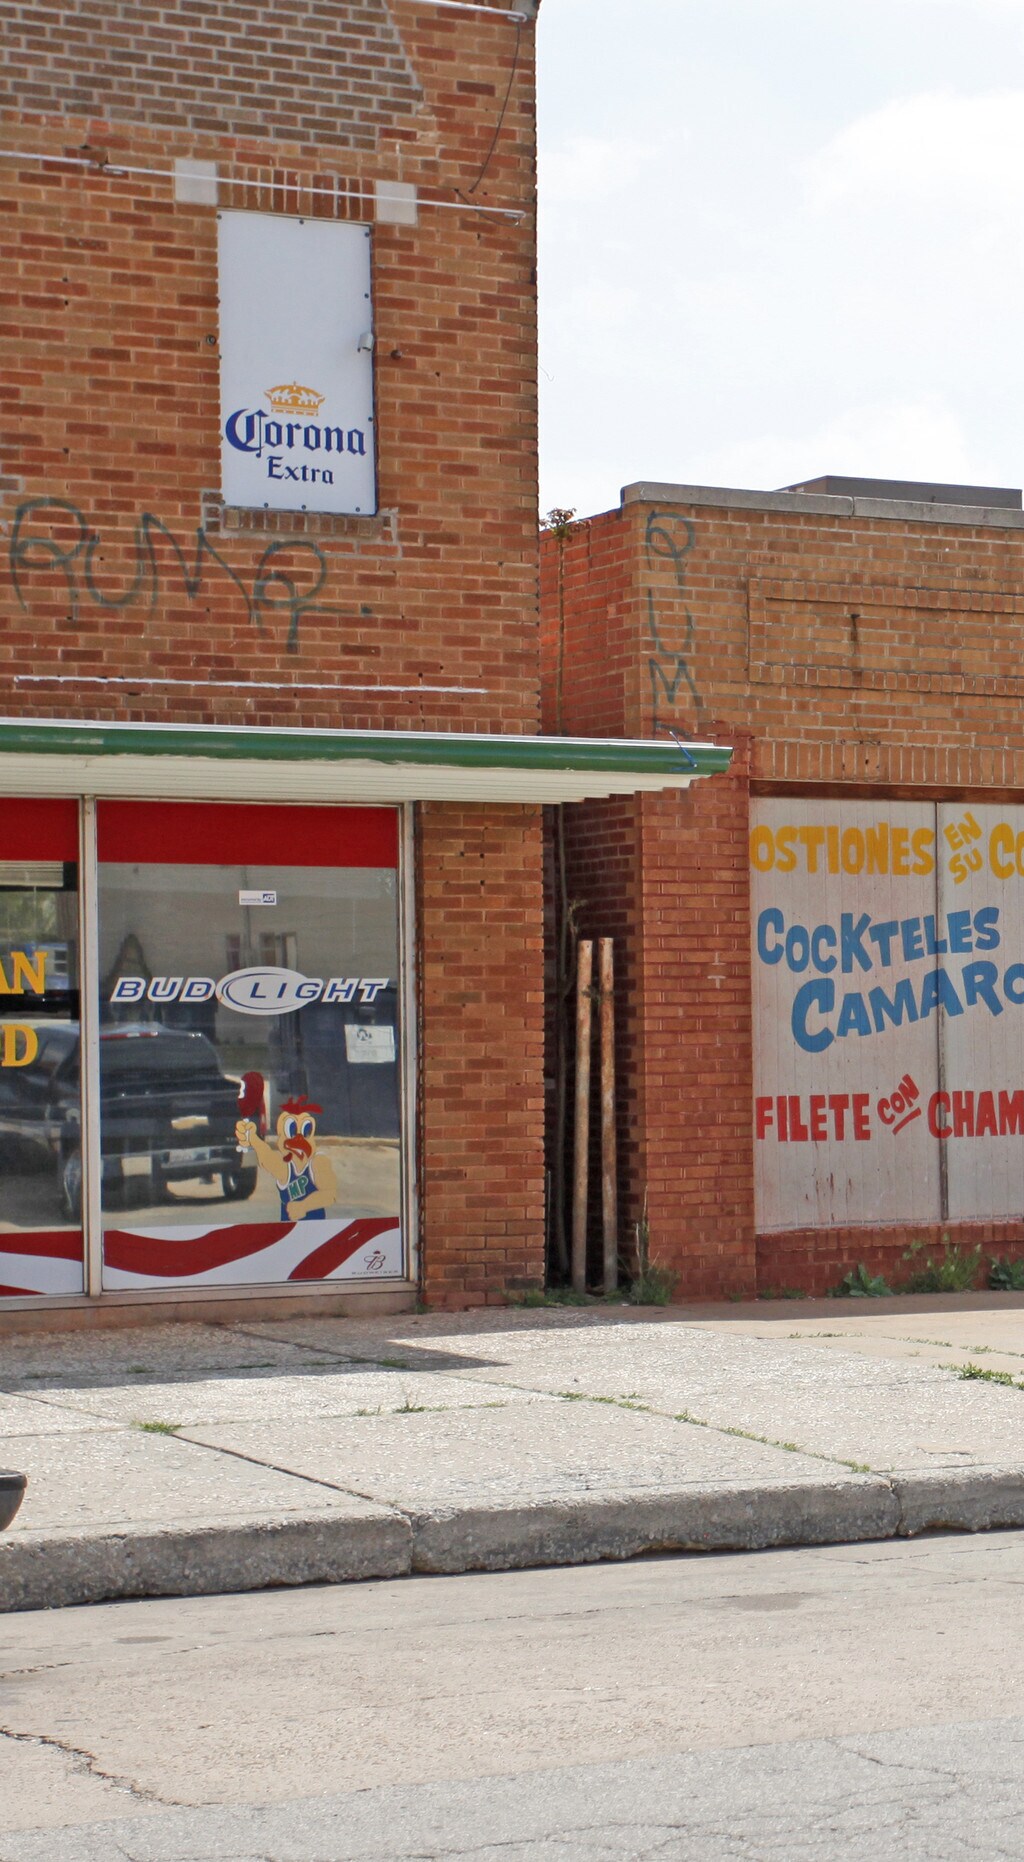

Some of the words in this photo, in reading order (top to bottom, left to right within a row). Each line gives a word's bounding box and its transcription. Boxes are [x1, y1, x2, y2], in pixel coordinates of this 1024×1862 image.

[225, 408, 367, 459] Corona
[267, 455, 335, 485] Extra
[750, 822, 936, 877] OSTIONES
[943, 811, 983, 851] EN
[948, 847, 984, 886] SU
[757, 906, 1001, 974] COCKTELES
[111, 976, 216, 1002] BUD
[248, 976, 390, 1003] LIGHT
[756, 1093, 872, 1142] FILETE
[877, 1073, 920, 1126] CON
